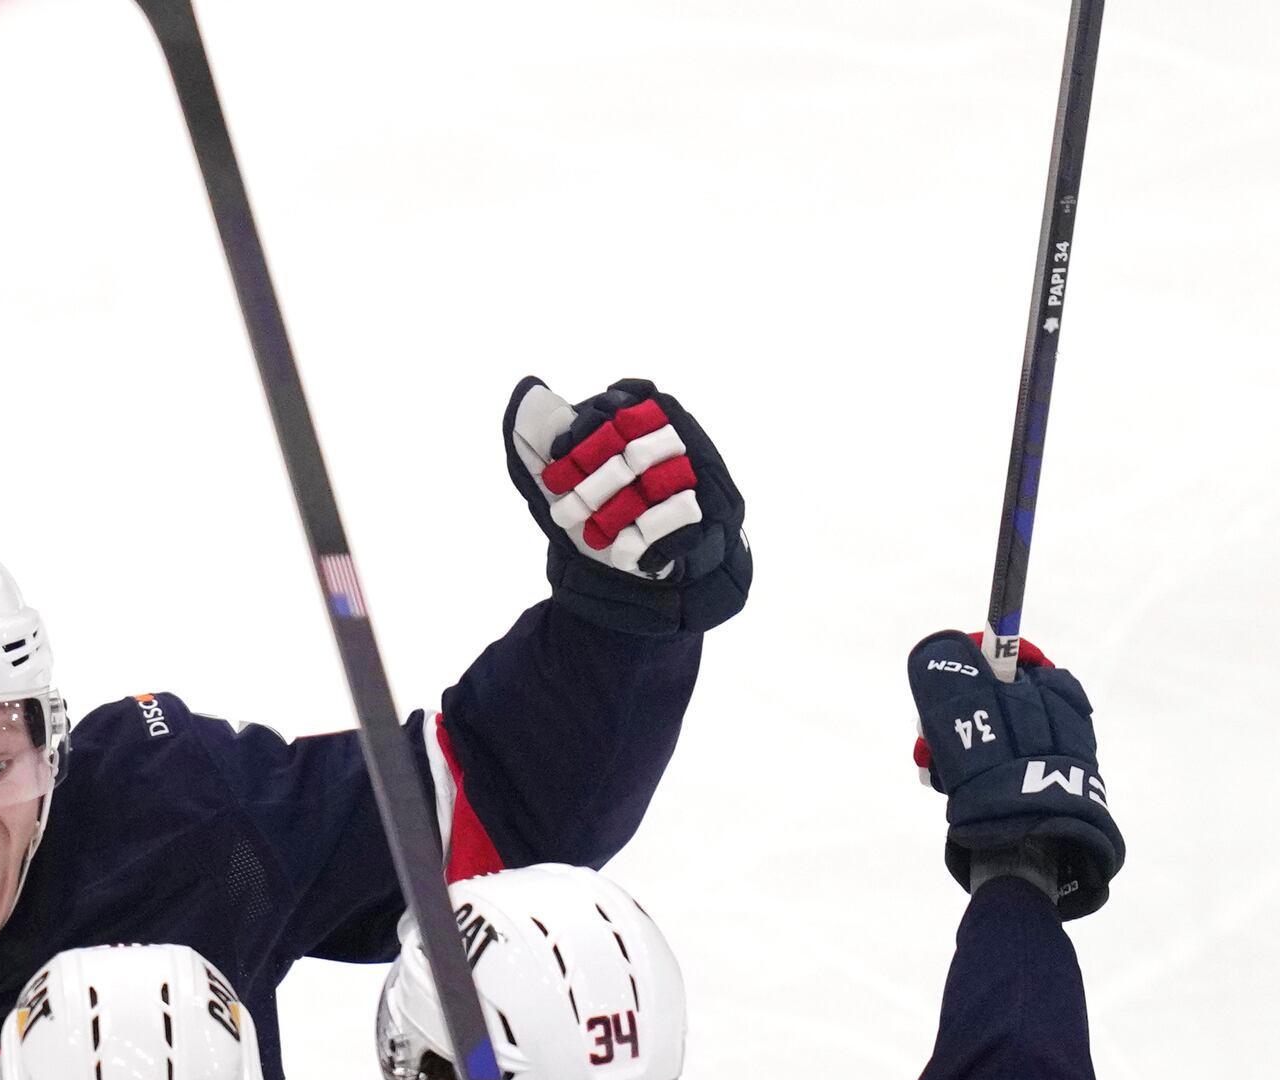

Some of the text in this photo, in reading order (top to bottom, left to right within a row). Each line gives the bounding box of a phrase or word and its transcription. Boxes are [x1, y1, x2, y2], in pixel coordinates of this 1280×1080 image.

[1047, 241, 1070, 306] PAPI 34
[927, 659, 980, 677] CCM
[954, 709, 996, 750] 34
[587, 1010, 640, 1066] 34
